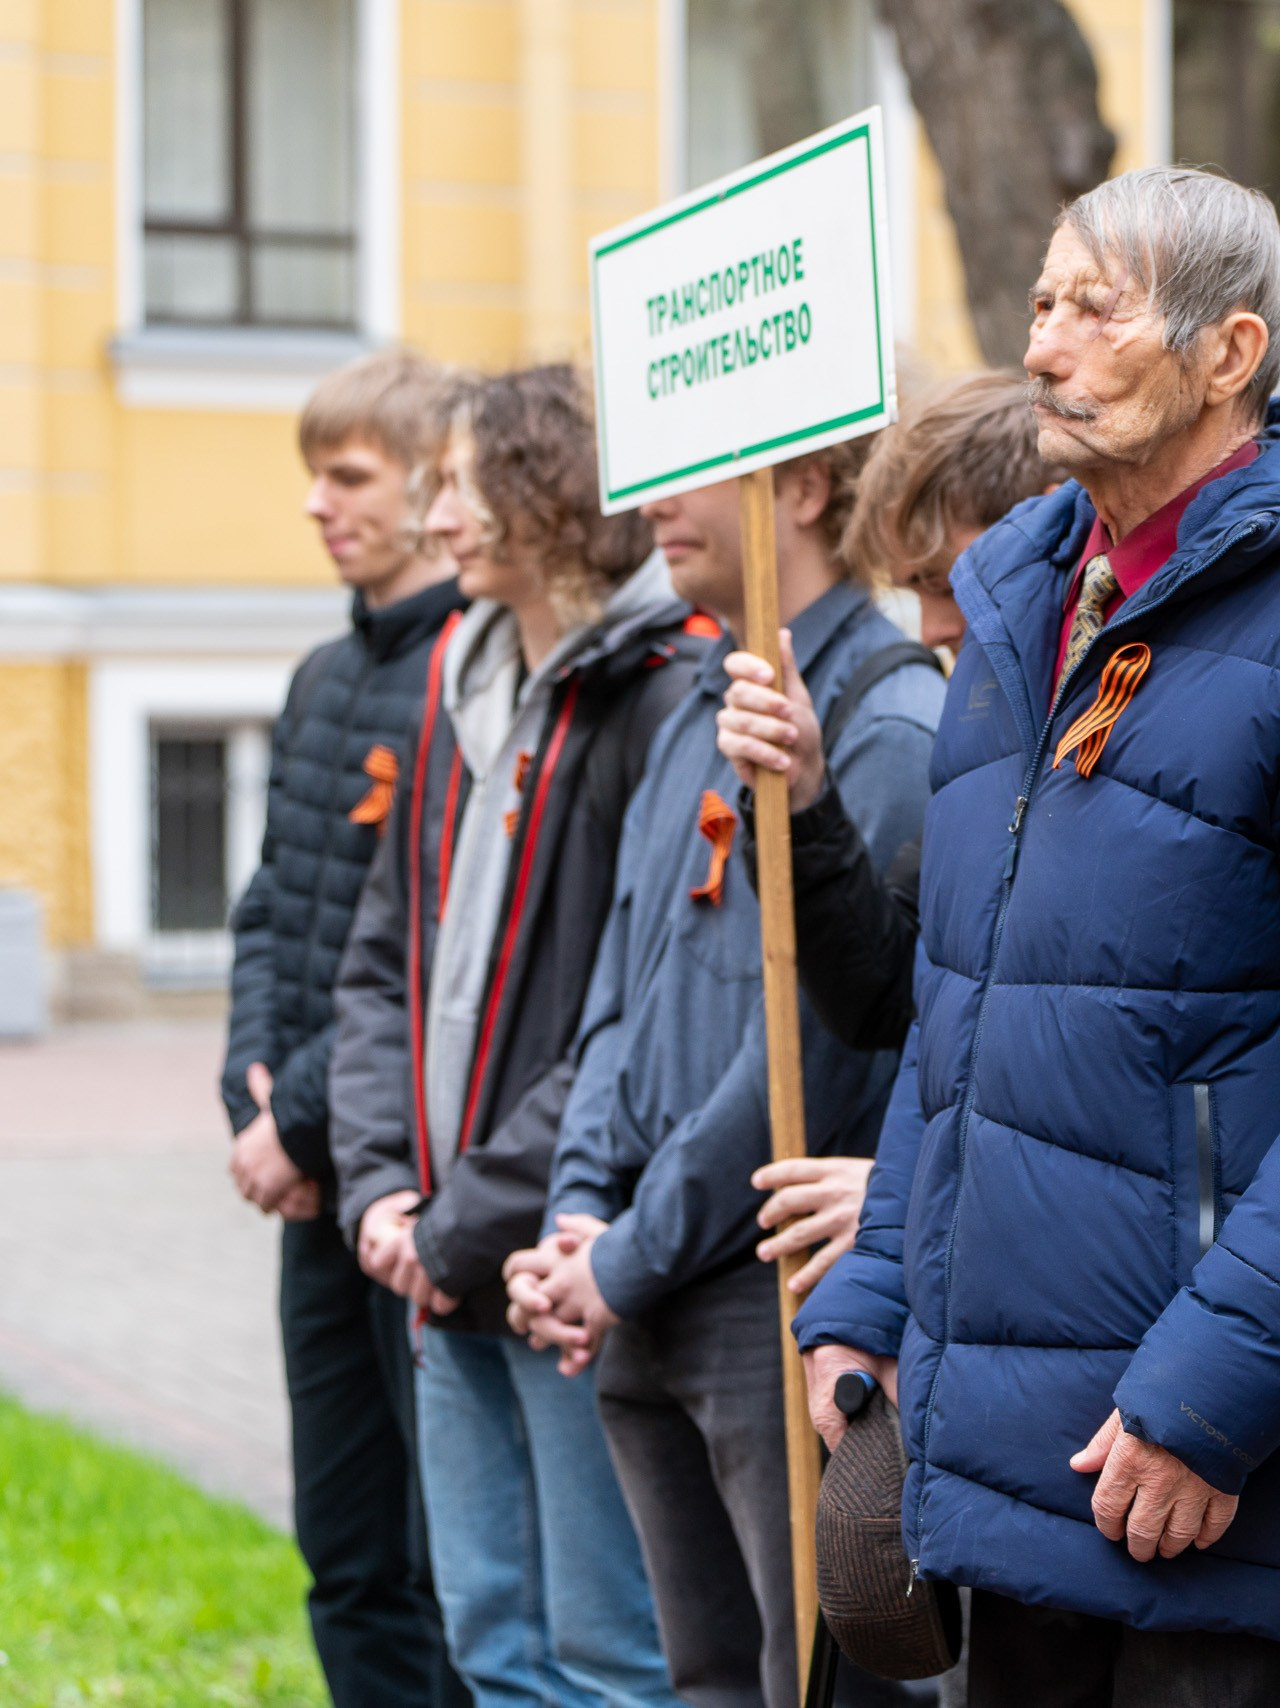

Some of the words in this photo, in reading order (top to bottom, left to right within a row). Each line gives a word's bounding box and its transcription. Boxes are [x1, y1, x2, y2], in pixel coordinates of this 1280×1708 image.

[646, 238, 804, 337] ТРАНСПОРТНОЕ
[647, 302, 812, 400] СТРОИТЕЛЬСТВО
[1180, 1401, 1232, 1447] VICTORY
